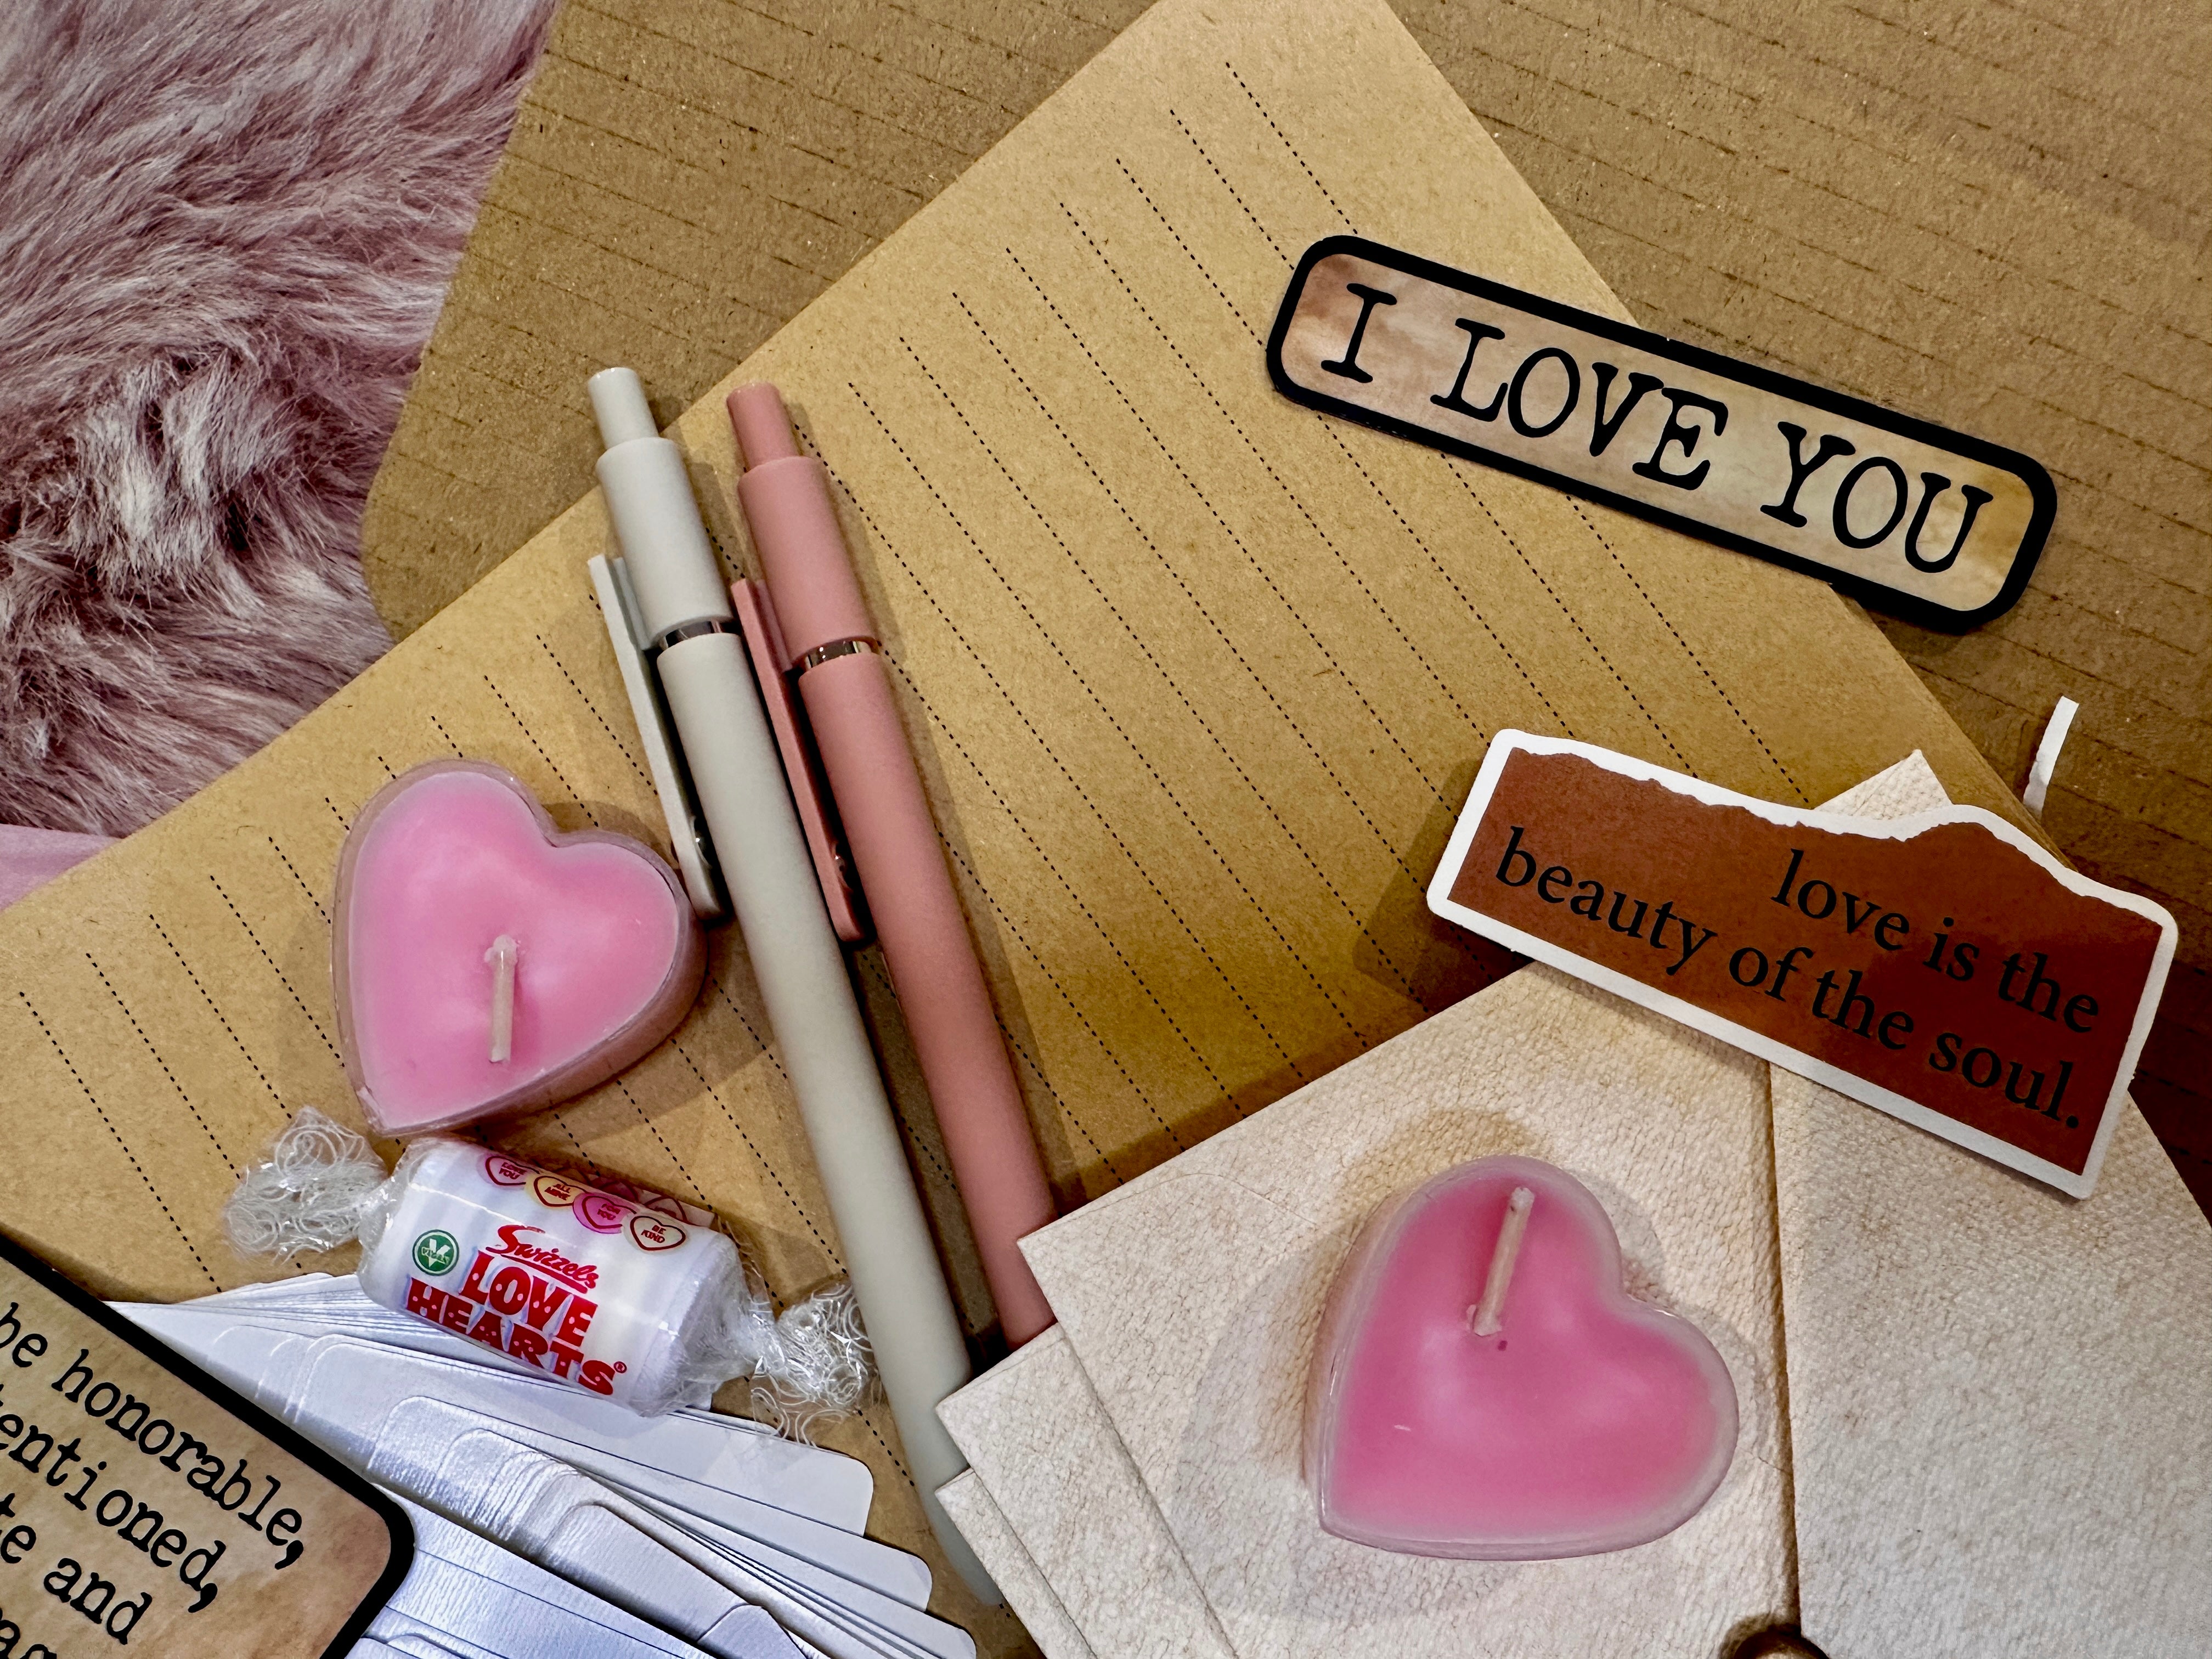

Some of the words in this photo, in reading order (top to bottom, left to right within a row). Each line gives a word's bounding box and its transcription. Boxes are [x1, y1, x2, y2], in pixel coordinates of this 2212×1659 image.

[1321, 283, 1397, 383] I
[1430, 318, 1729, 490] LOVE
[1760, 421, 1994, 573] YOU
[1495, 826, 1717, 975] beauty
[1729, 946, 1815, 1002] of
[1812, 969, 1915, 1050] the
[1928, 1031, 2080, 1128] soul.
[1771, 849, 1910, 951] love
[1923, 916, 1979, 983] is
[1998, 952, 2100, 1033] the
[459, 1250, 598, 1347] LOVE
[0, 1384, 226, 1613] entioned,
[51, 1348, 304, 1570] honorable,
[43, 1558, 153, 1645] and
